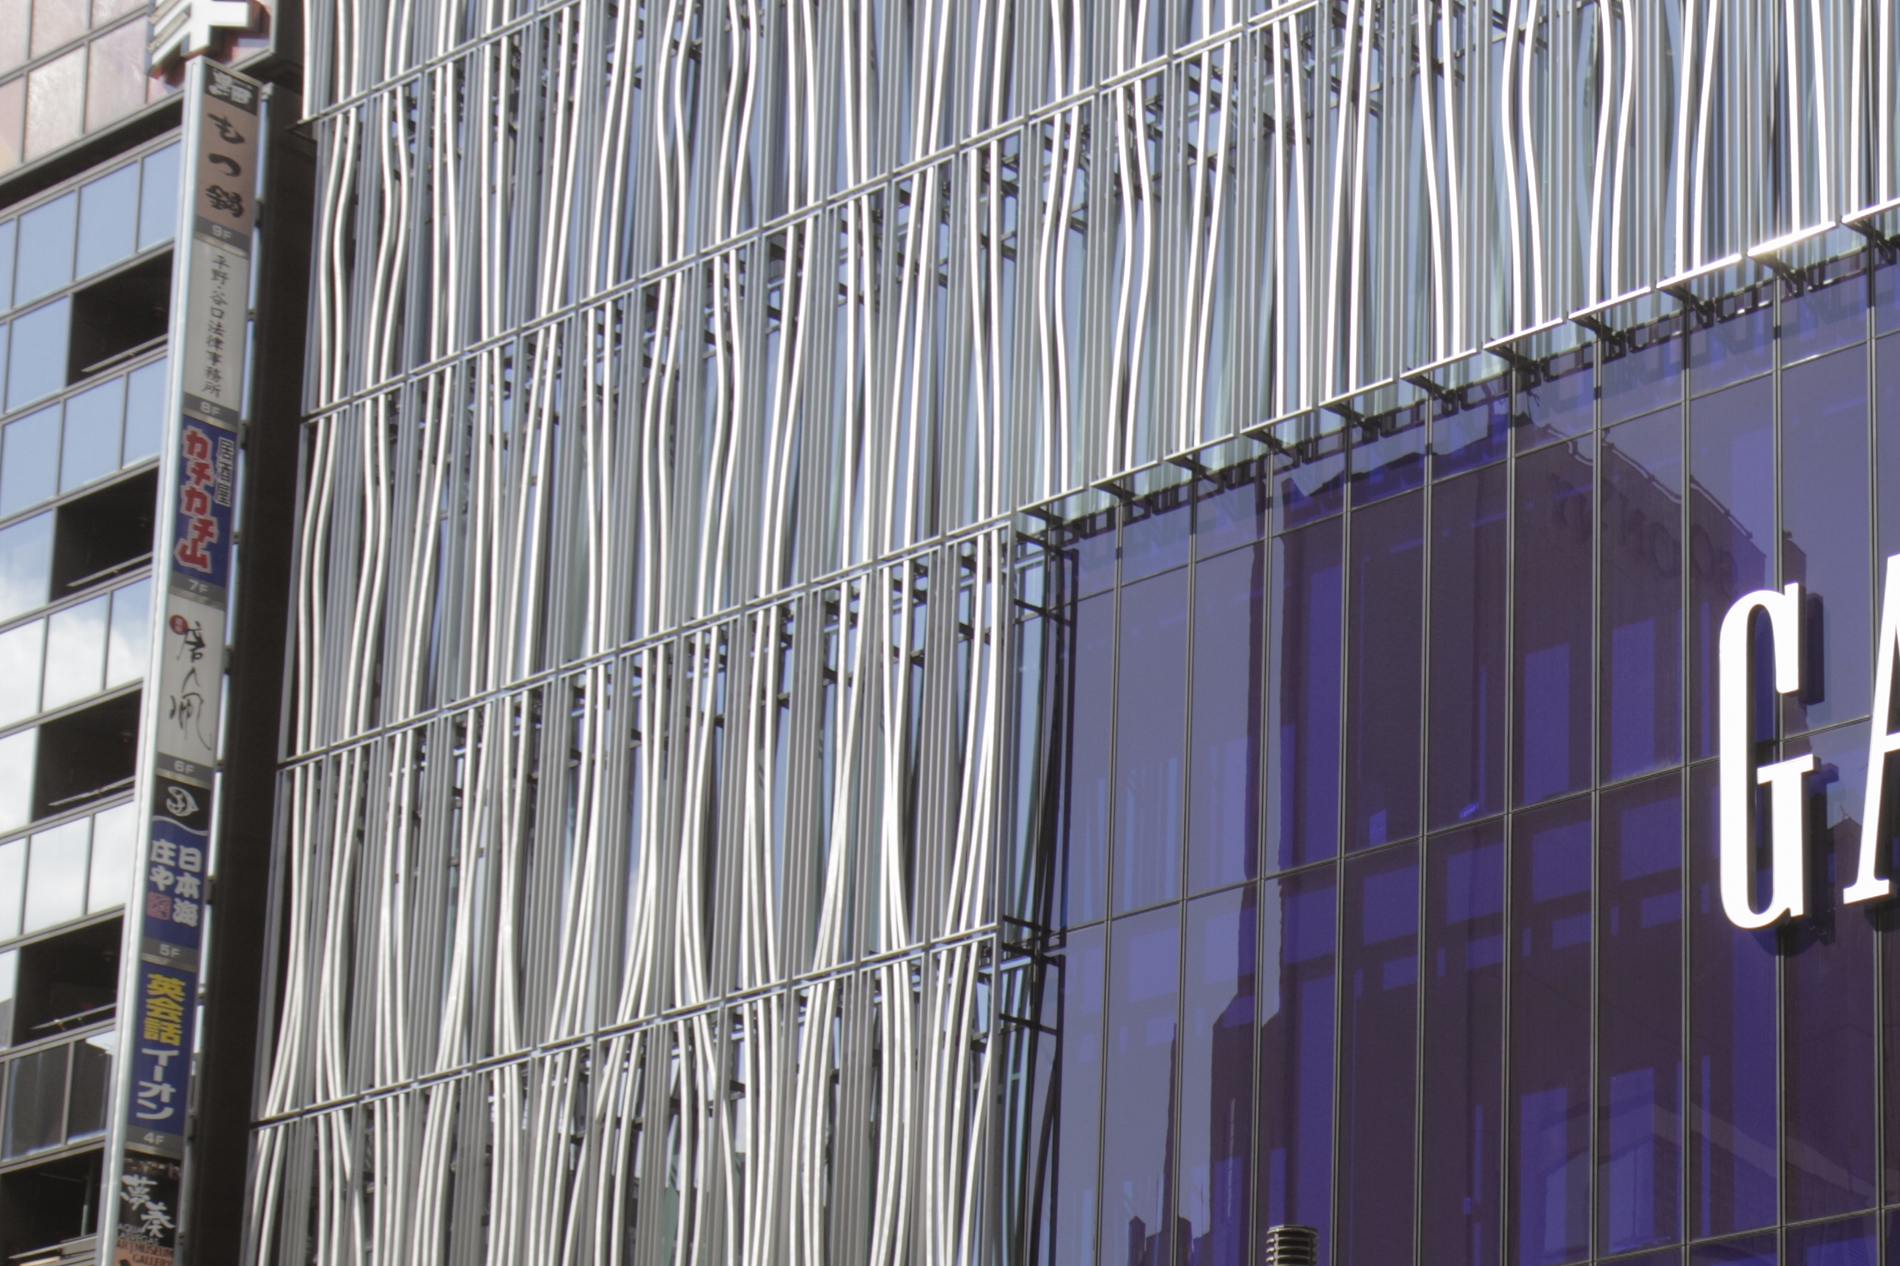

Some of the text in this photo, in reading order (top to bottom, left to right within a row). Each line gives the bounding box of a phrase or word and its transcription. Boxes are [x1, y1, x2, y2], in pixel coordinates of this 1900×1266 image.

[204, 112, 245, 219] もつ鍋
[212, 224, 232, 240] 9F
[201, 401, 220, 416] 8F
[175, 427, 217, 573] カチカチ山
[188, 579, 209, 594] 7F
[174, 760, 195, 774] 6F
[149, 837, 177, 891] 庄や
[172, 842, 202, 927] 日本海
[159, 943, 180, 958] 5F
[143, 1131, 164, 1146] 4F
